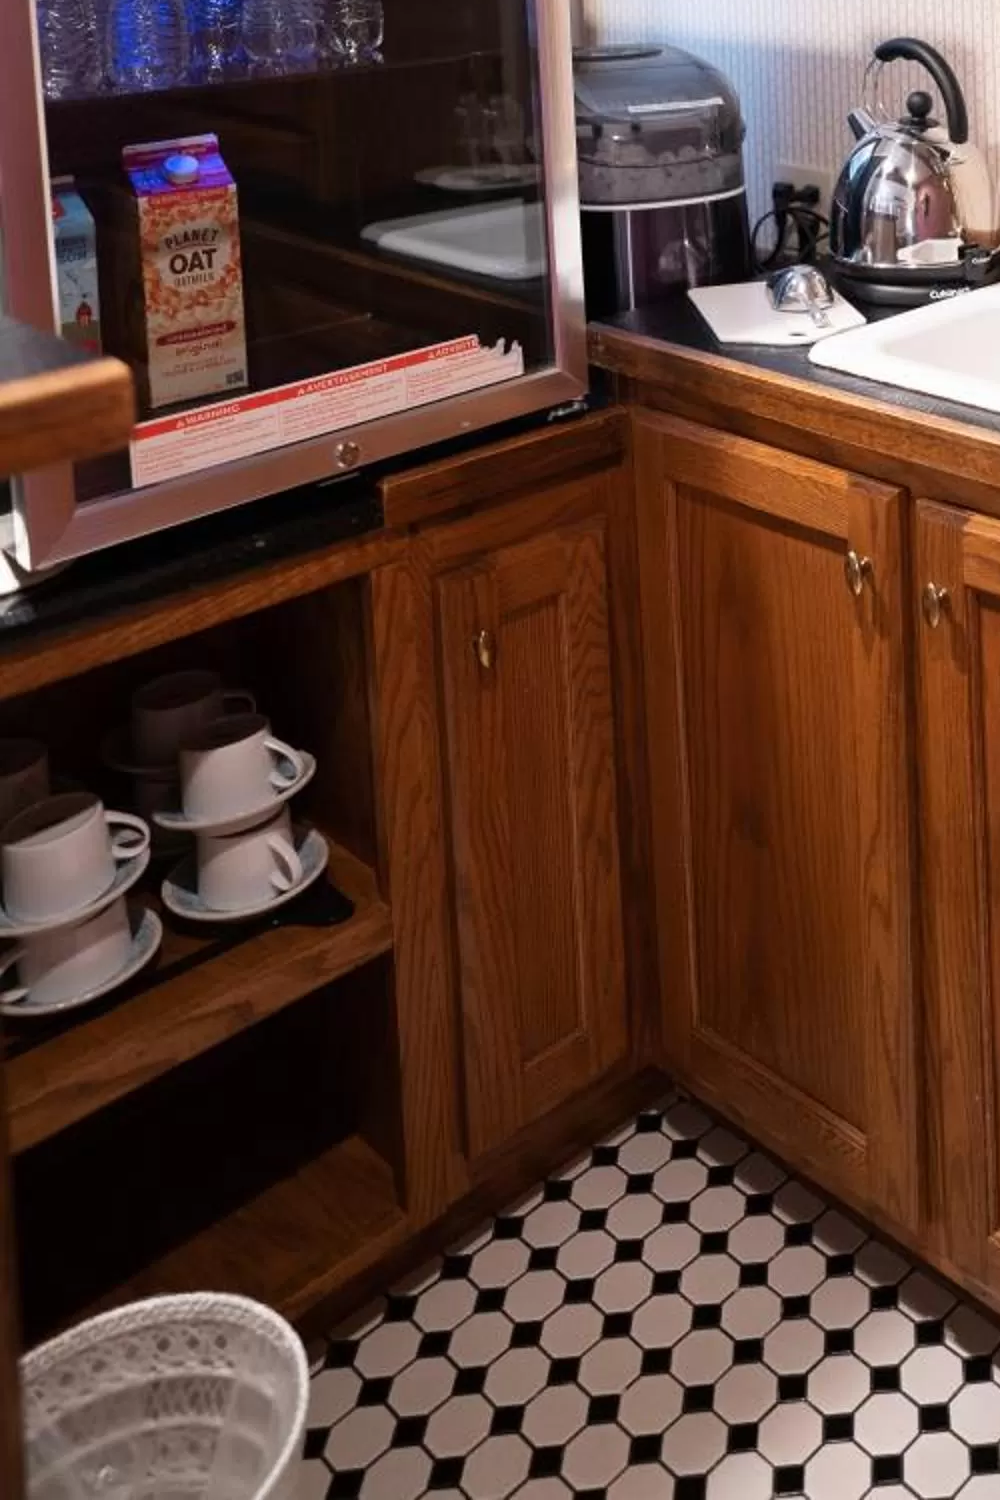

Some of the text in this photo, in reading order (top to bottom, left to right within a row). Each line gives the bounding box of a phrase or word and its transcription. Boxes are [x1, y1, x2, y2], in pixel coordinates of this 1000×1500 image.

[164, 227, 219, 248] PLANET
[169, 249, 217, 274] OAT
[185, 403, 241, 425] WARNING
